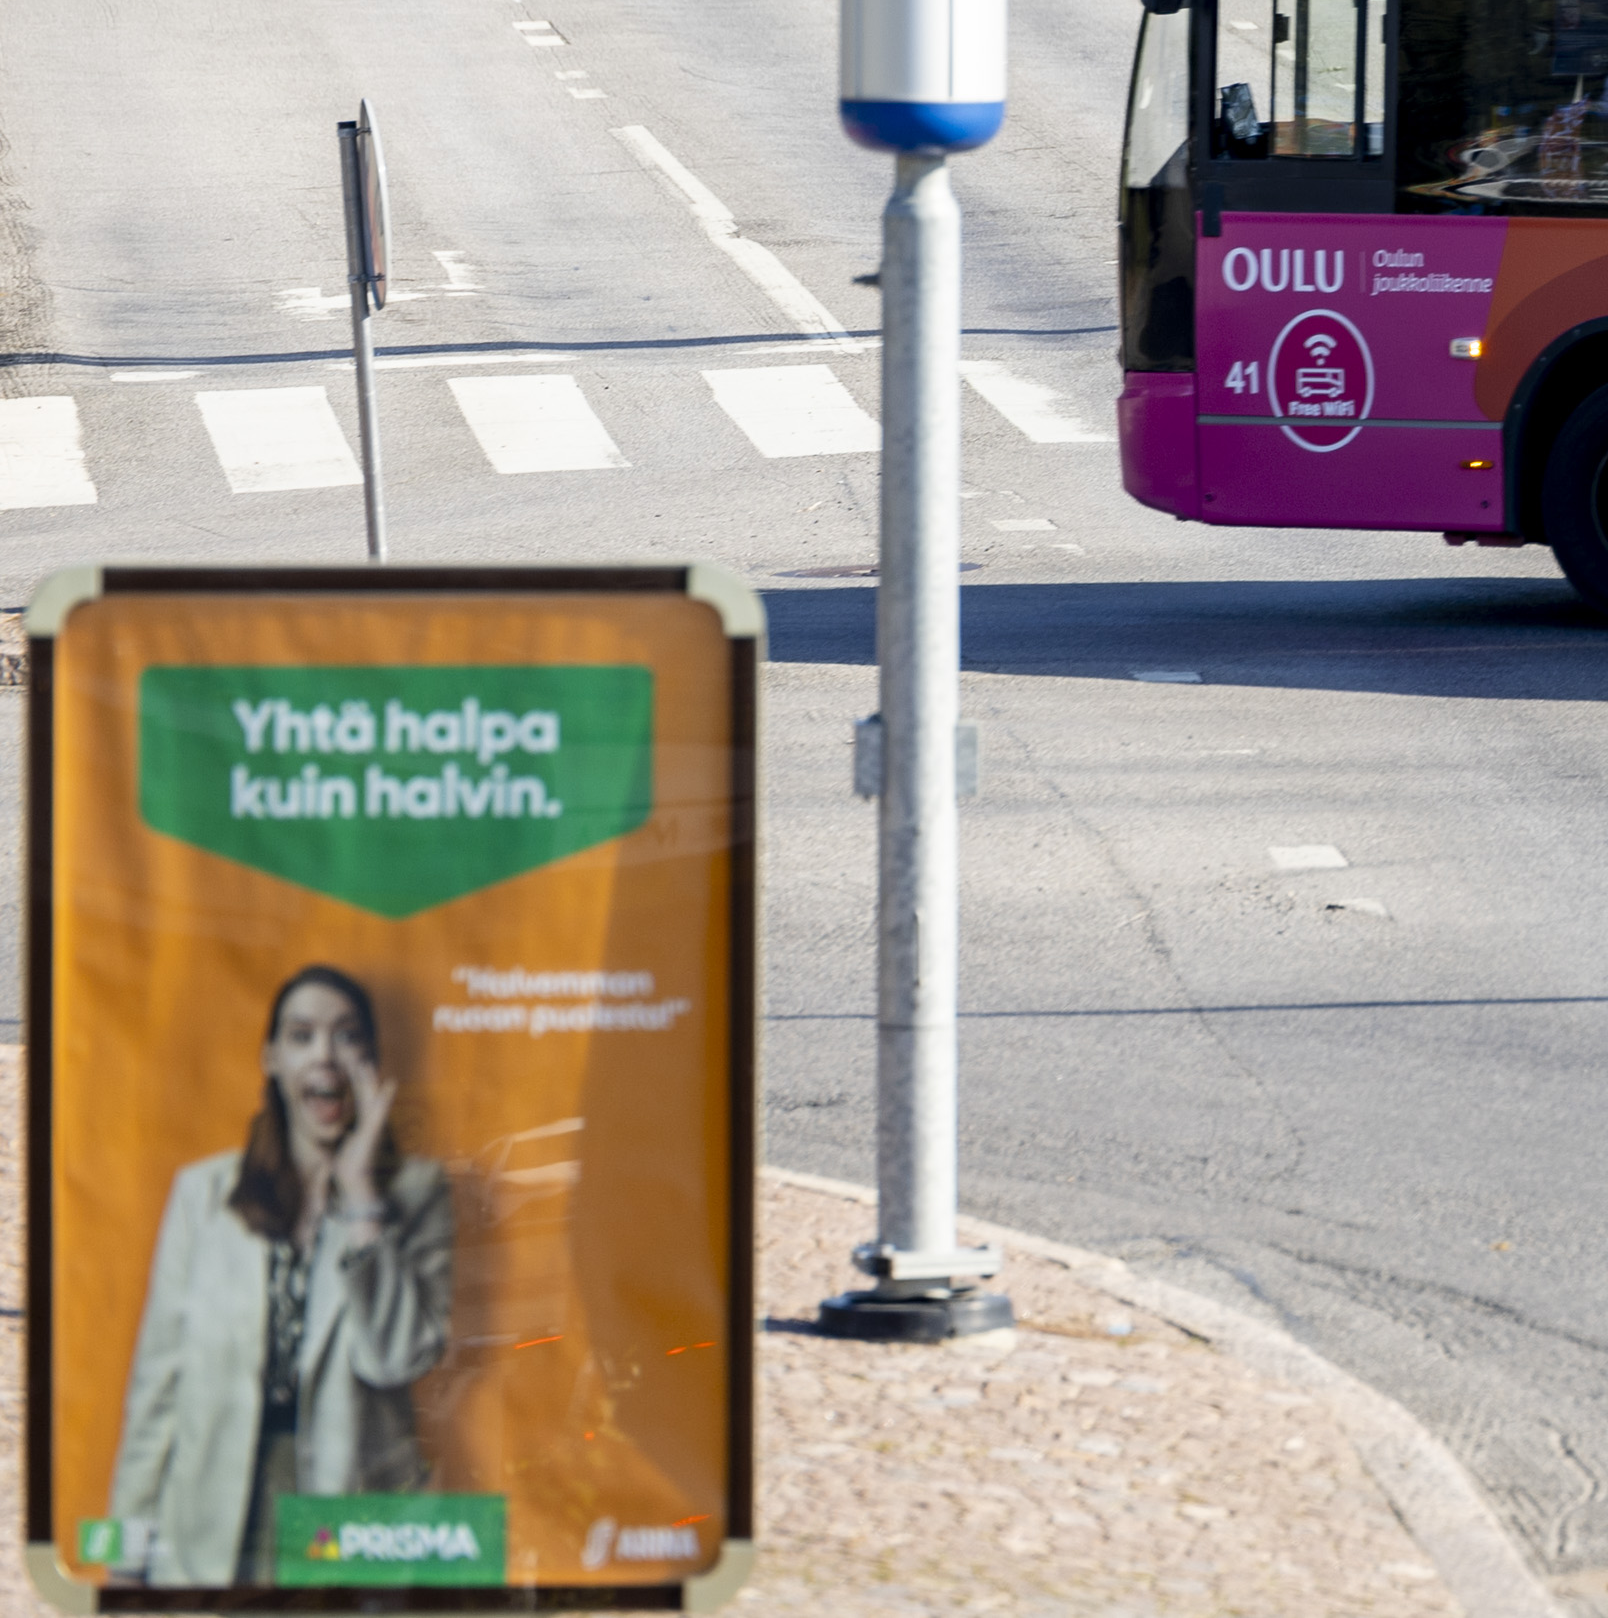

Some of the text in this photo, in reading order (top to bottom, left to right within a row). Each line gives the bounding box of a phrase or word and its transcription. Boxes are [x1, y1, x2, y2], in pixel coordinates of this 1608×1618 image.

[1222, 246, 1344, 293] OULU
[1373, 249, 1424, 268] Oulun
[1370, 272, 1493, 295] joukkoliikenne
[1225, 361, 1260, 394] 41
[1288, 400, 1321, 416] Free
[233, 699, 560, 766] Yhtä halpa
[231, 768, 562, 818] kuin halvin.
[340, 1522, 480, 1560] PRISMA
